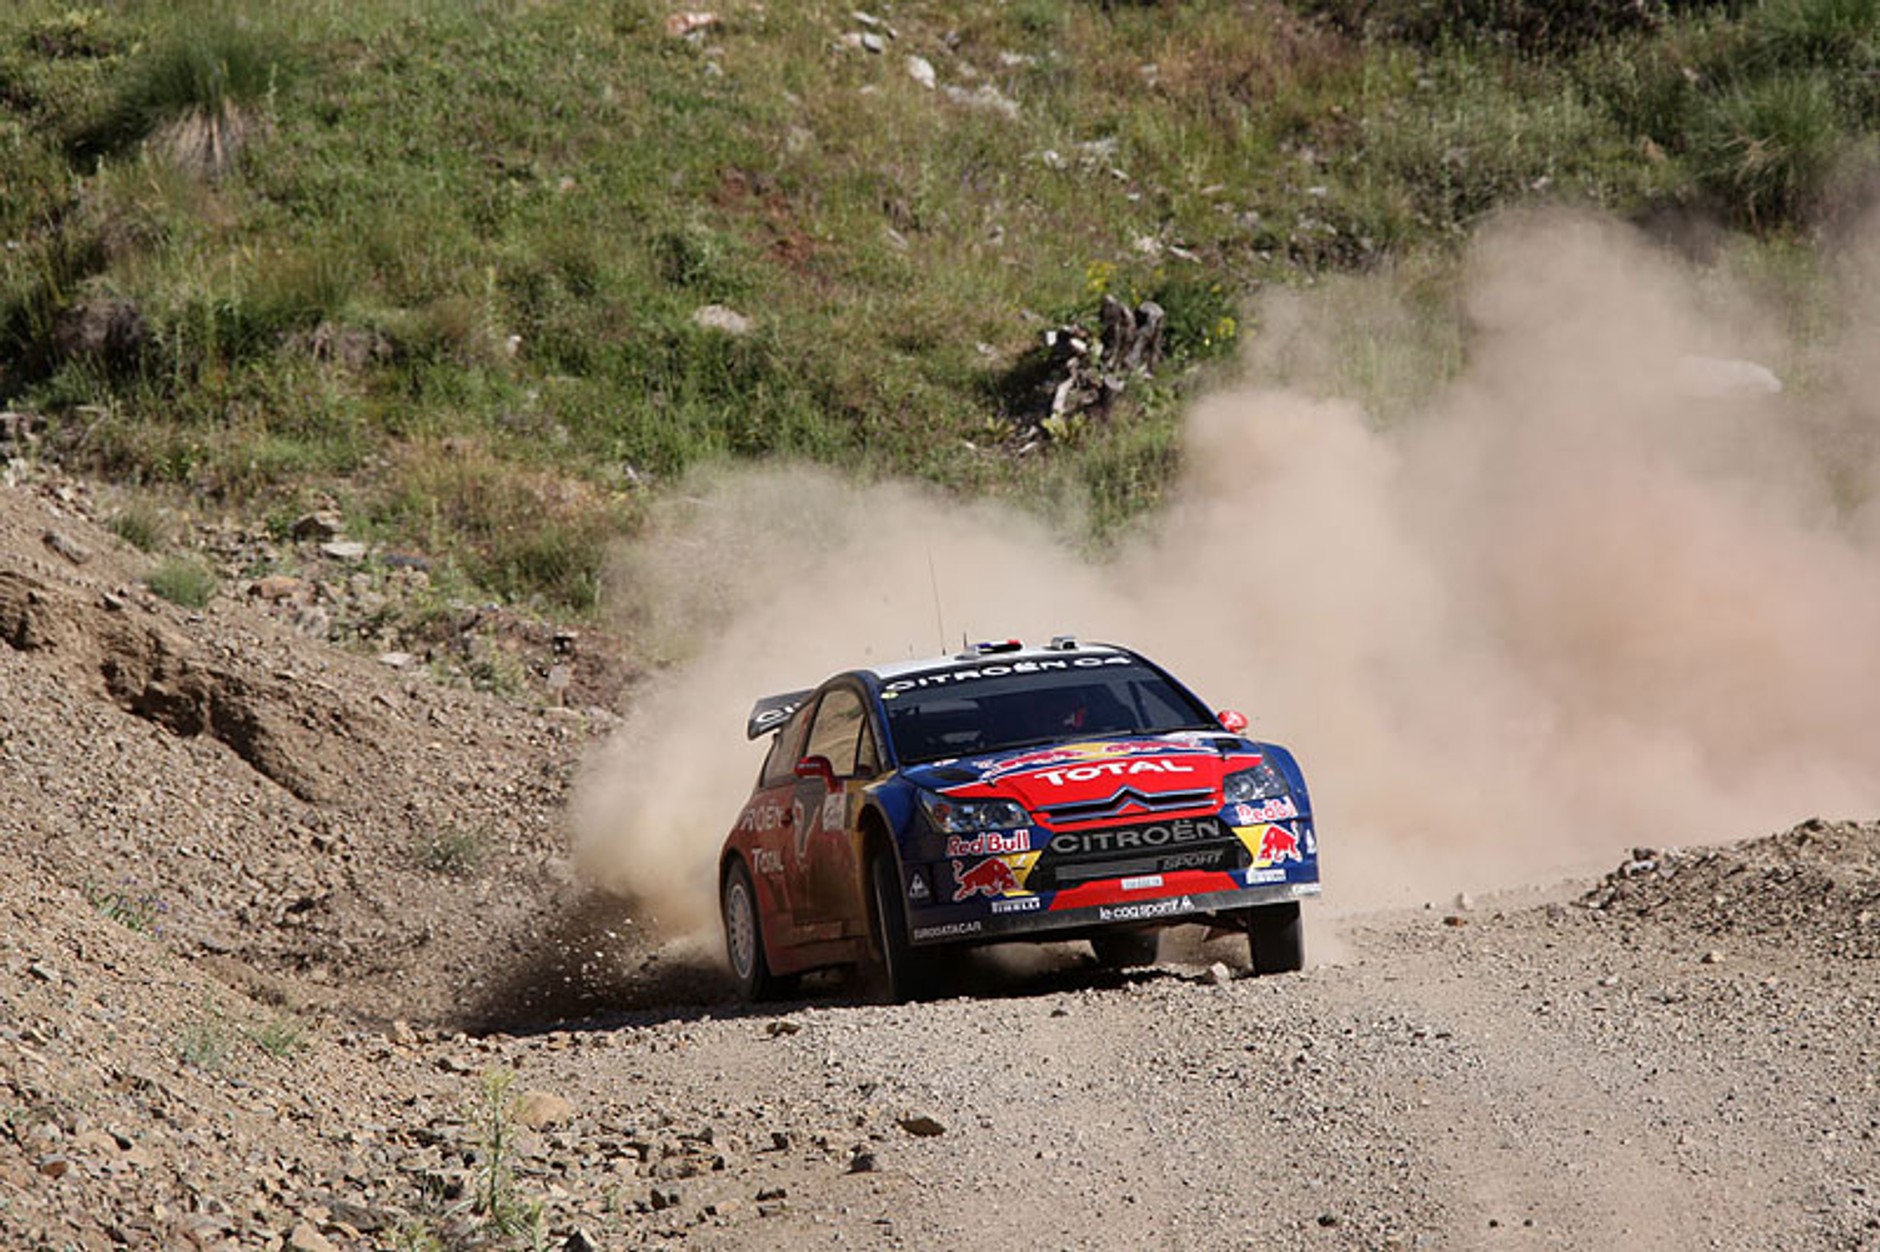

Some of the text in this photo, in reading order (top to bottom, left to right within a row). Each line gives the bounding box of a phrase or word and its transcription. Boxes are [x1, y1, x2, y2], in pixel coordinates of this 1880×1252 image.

[1073, 656, 1132, 667] C4
[1034, 759, 1194, 786] TOTAL
[946, 829, 1031, 858] Red Bull
[1050, 818, 1221, 854] CITROËN
[1163, 851, 1224, 870] SPORT
[991, 897, 1040, 914] PIRELLI
[1099, 906, 1112, 920] le
[1113, 905, 1139, 918] coq
